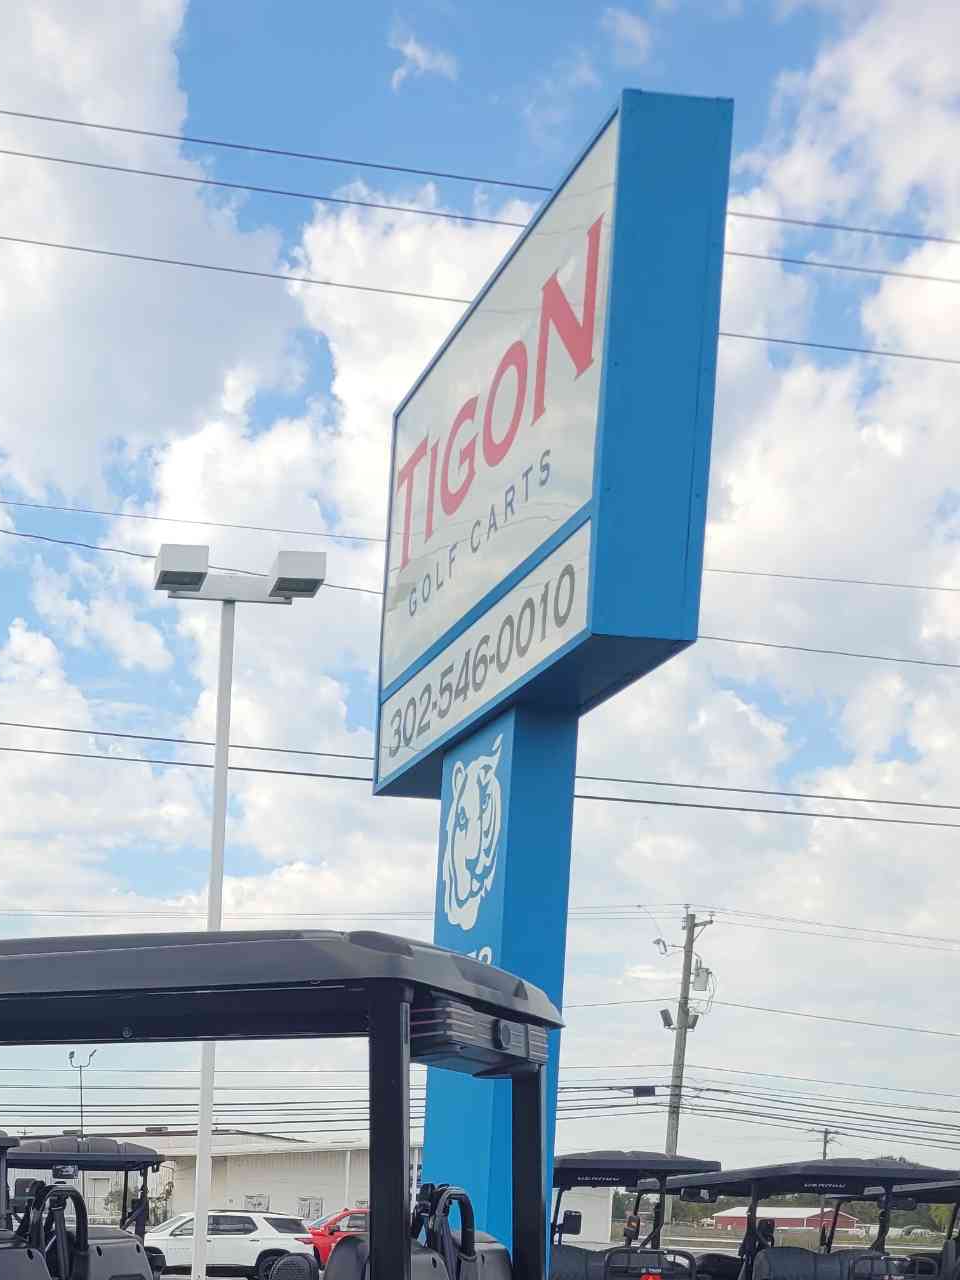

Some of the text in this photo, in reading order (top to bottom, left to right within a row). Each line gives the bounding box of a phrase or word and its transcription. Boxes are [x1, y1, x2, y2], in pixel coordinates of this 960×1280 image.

[396, 212, 605, 572] TIGON
[408, 448, 552, 617] GOLF CARTS
[389, 562, 576, 758] 302-546-0010
